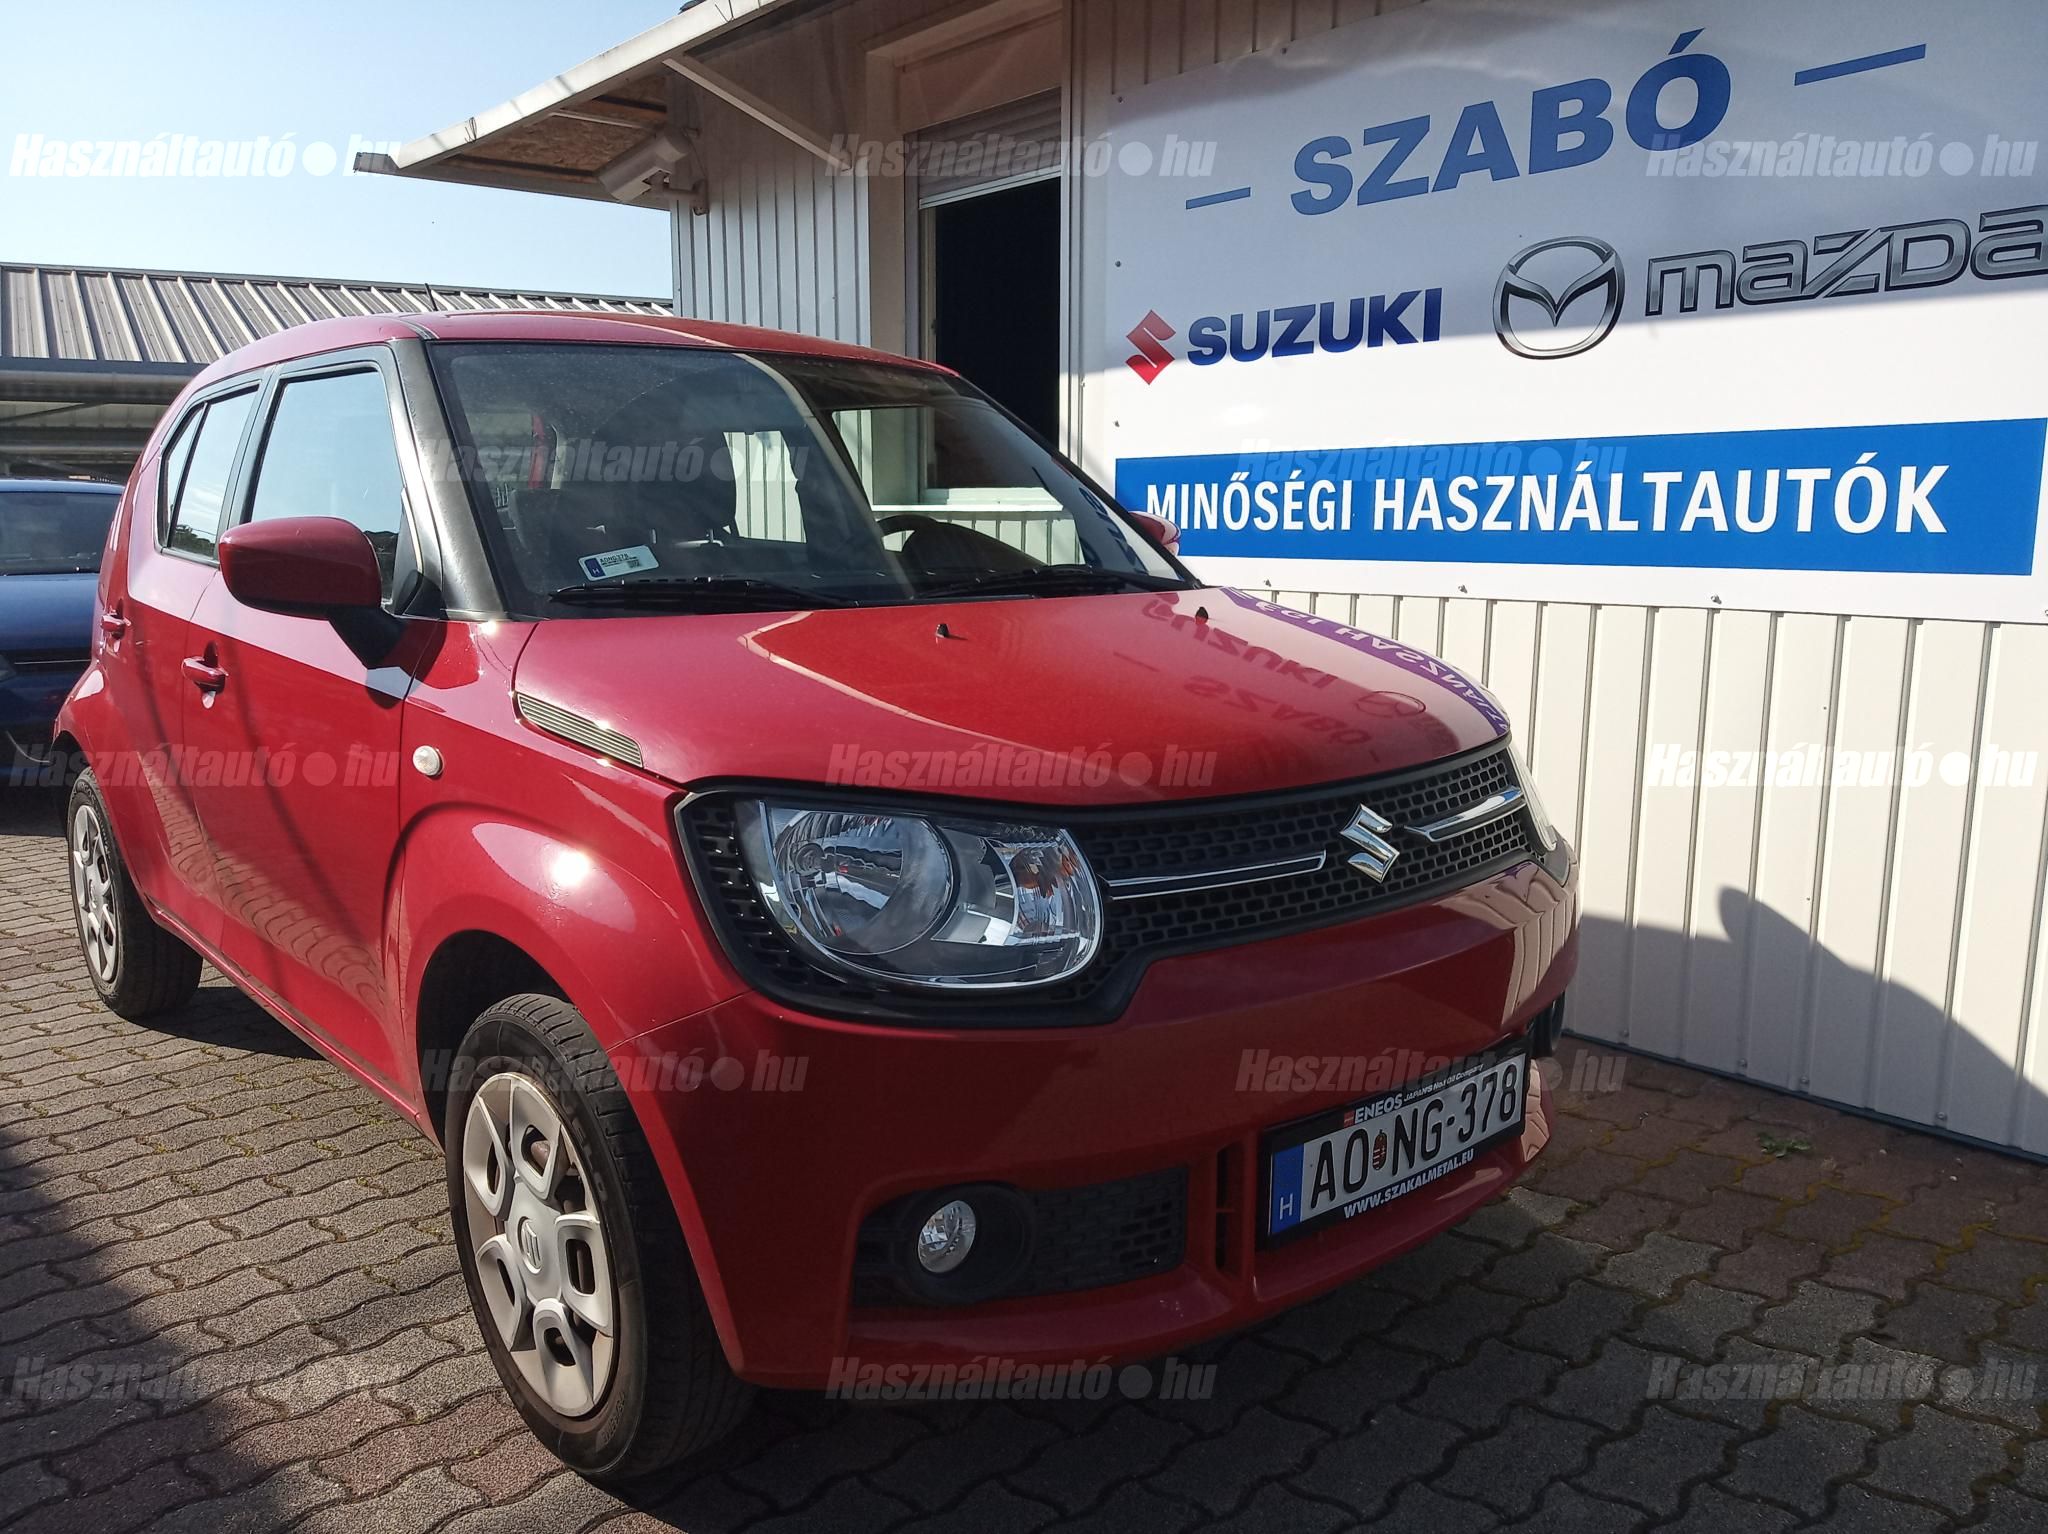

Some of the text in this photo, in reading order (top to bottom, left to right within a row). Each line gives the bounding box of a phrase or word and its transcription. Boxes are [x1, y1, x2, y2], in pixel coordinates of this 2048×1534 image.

[1290, 28, 1732, 217] SZABÓ
[1187, 287, 1442, 366] SUZUKI
[1146, 452, 1950, 535] MINŐSÉGI HASZNÁLTAUTÓK
[1310, 1064, 1517, 1209] AO NG-378
[1354, 1093, 1402, 1124] ENEOS
[1280, 1193, 1294, 1220] H
[1343, 1148, 1474, 1219] WWW.SZAKALMETAL.EU
